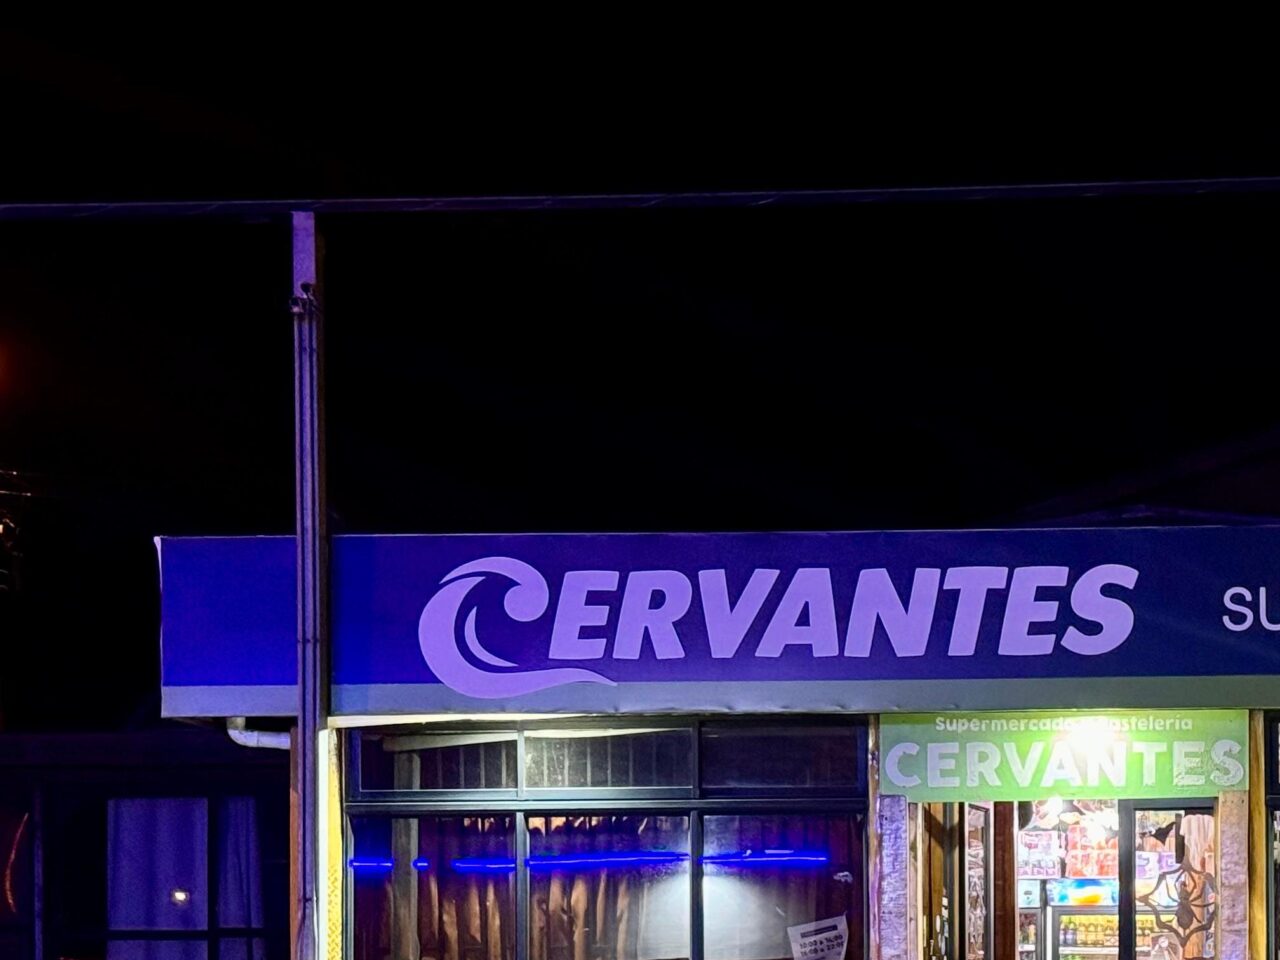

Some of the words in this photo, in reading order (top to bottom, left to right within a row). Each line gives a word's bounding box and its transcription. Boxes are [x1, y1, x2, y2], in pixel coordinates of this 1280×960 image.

[418, 556, 1140, 699] CERVANTES
[1097, 714, 1193, 731] astelería
[884, 738, 1246, 791] CERVANTES
